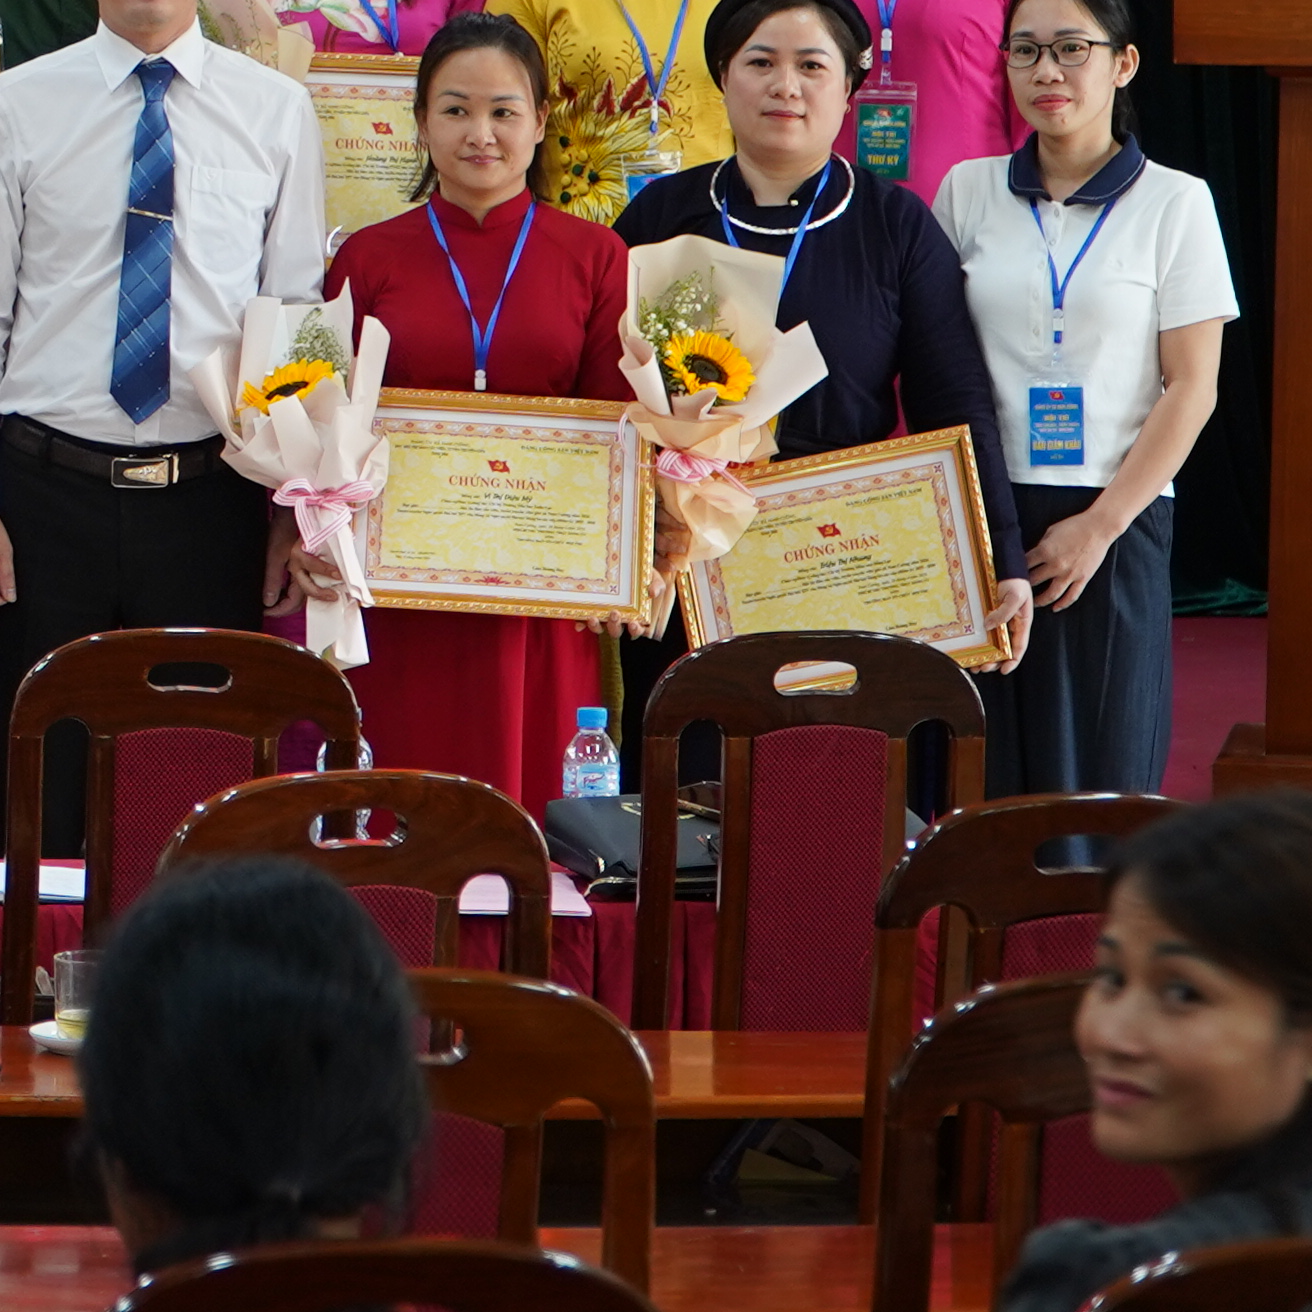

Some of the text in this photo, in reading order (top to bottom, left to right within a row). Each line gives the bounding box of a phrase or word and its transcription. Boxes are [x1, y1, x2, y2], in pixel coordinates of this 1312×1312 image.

[335, 136, 385, 151] CHỨNG
[449, 473, 547, 493] CHỨNG NHẬN
[784, 534, 881, 563] CHỨNG NHẬN
